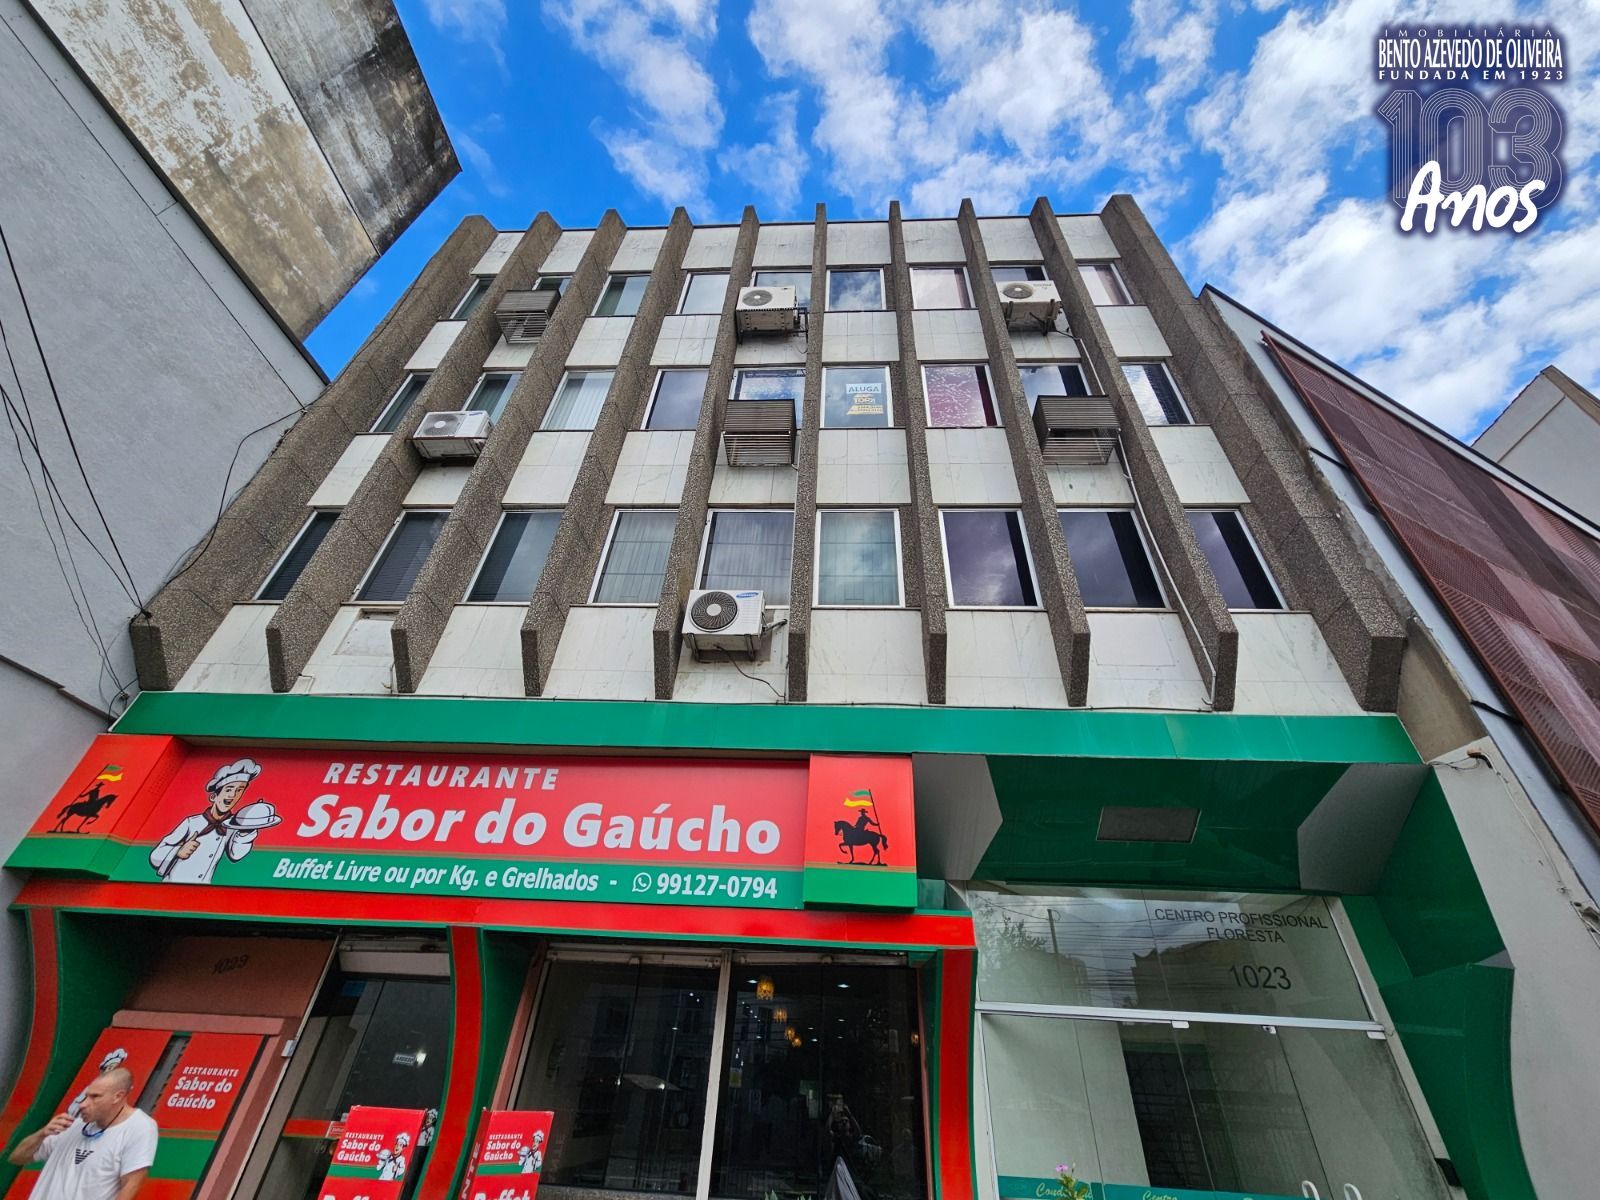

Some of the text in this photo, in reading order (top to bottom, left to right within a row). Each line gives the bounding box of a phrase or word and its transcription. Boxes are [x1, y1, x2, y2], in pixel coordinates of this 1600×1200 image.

[322, 762, 560, 791] RESTAURANTE
[296, 794, 781, 854] Sabor do Gaúcho
[272, 857, 333, 880] Buffet
[333, 860, 382, 883] Livre
[384, 865, 410, 884] ou
[410, 867, 447, 889] por
[449, 864, 479, 891] Kg.
[484, 869, 497, 887] e
[502, 866, 599, 891] Grelhados
[656, 872, 778, 899] 99127-0794
[1154, 908, 1328, 929] CENTRO PROFISSIONAL
[1206, 927, 1285, 943] FLORESTA
[1230, 965, 1291, 990] 1023
[183, 1066, 239, 1077] RESTAURANTE
[175, 1076, 233, 1093] Sabor do
[167, 1093, 216, 1109] Gaúcho
[341, 1139, 381, 1151] Sabor do
[486, 1140, 521, 1150] Sabor do
[337, 1151, 371, 1162] Gaúcho
[484, 1151, 514, 1161] Gaúcho
